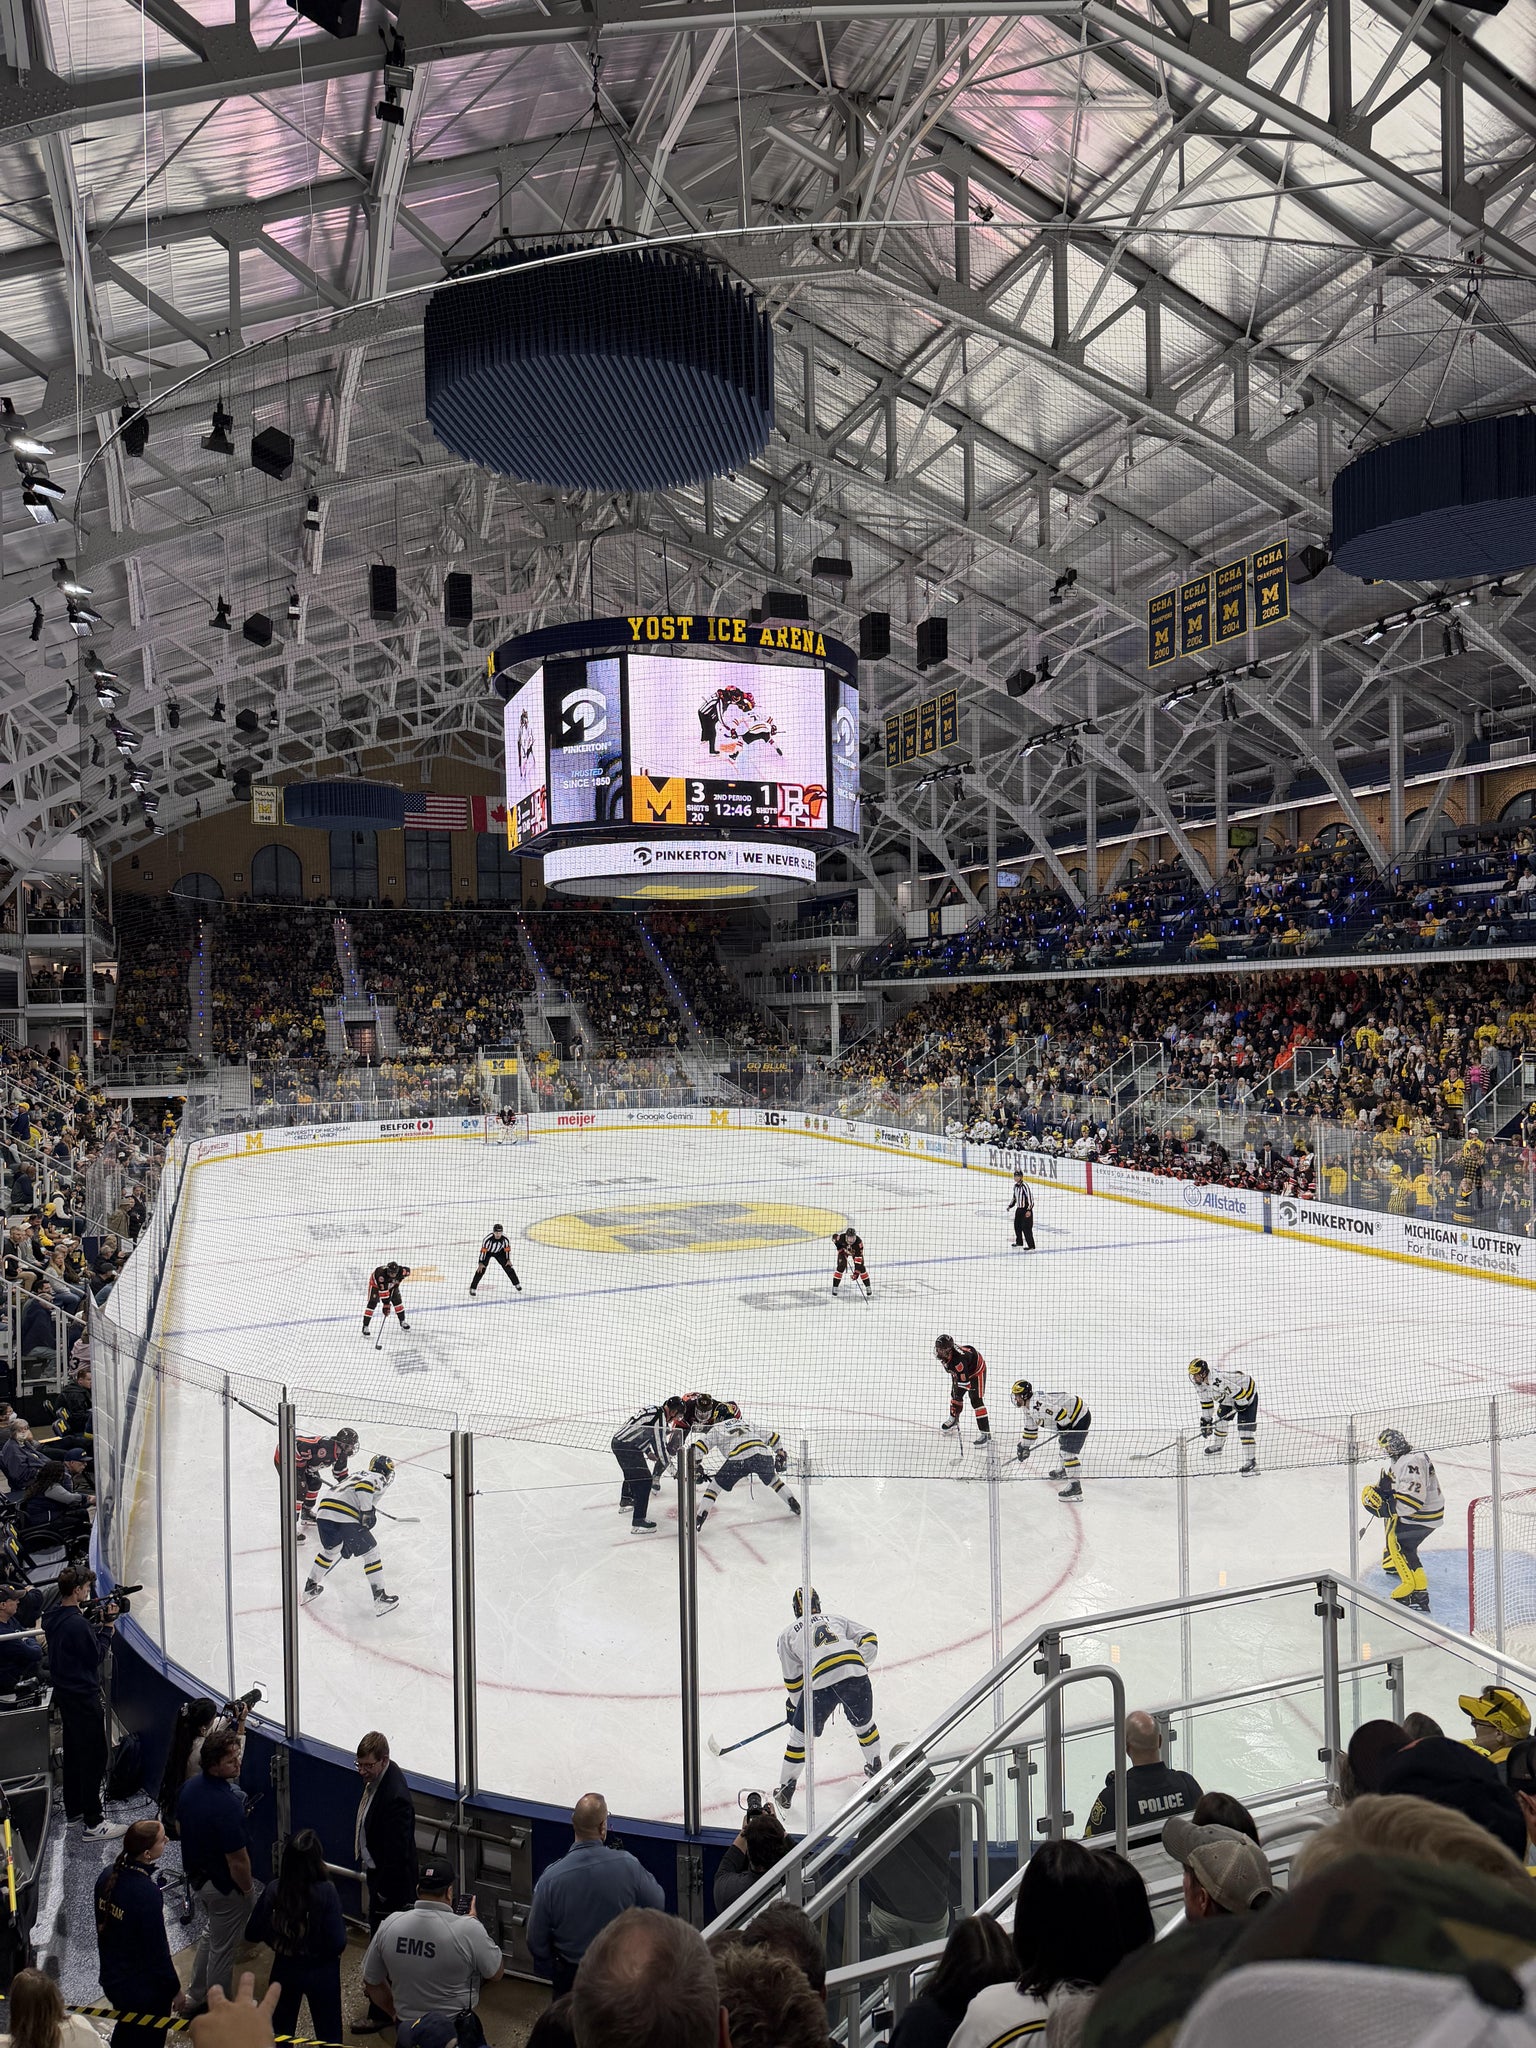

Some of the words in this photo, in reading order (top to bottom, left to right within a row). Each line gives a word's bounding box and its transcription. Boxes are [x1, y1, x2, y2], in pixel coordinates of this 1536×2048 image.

[1256, 548, 1283, 569] CCHA
[1218, 566, 1242, 585] CCHA
[1256, 565, 1284, 582] CHAMPIONS
[1184, 582, 1207, 600] CCHA
[1261, 582, 1279, 606] M
[1151, 596, 1173, 613] CCHA
[1223, 599, 1239, 621] M
[1262, 604, 1280, 620] 2005
[1187, 613, 1203, 635] M
[628, 616, 694, 641] YOST
[708, 617, 747, 643] ICE
[759, 625, 827, 657] ARENA
[1155, 626, 1169, 647] M
[1186, 634, 1203, 648] 2002
[943, 717, 952, 733] M
[906, 734, 914, 748] M
[924, 726, 932, 741] M
[888, 741, 896, 754] M
[571, 768, 604, 777] TRUSTED
[563, 778, 590, 789] SINCE
[592, 777, 611, 787] 1850
[691, 782, 706, 803] 3
[728, 794, 752, 802] PERIOD
[760, 785, 770, 806] 1
[258, 803, 272, 814] M
[686, 804, 710, 812] SHOTS
[715, 803, 753, 817] 12:46
[691, 813, 704, 822] 20
[763, 815, 770, 824] 9
[743, 853, 764, 864] WE
[767, 854, 799, 868] NEVER
[492, 1060, 505, 1070] M
[763, 1062, 787, 1070] BLUE
[557, 1112, 596, 1127] meijer
[636, 1112, 665, 1121] Google
[666, 1112, 694, 1120] Gemini
[710, 1109, 729, 1125] M
[380, 1122, 415, 1132] BELFOR
[246, 1132, 264, 1150] M
[988, 1148, 1058, 1180] MICHIGAN
[1202, 1192, 1247, 1214] Allstate
[1404, 1223, 1458, 1245] MICHIGAN
[1472, 1235, 1521, 1257] LOTTERY
[1407, 1240, 1424, 1254] For
[1426, 1242, 1449, 1260] fun.
[1451, 1249, 1469, 1263] For
[1471, 1254, 1520, 1275] schools.
[1033, 1400, 1042, 1411] M
[1407, 1465, 1420, 1475] M
[793, 1616, 830, 1633] BANETT
[813, 1622, 840, 1648] 4
[1138, 1792, 1185, 1815] POLICE
[395, 1936, 436, 1959] EMS
